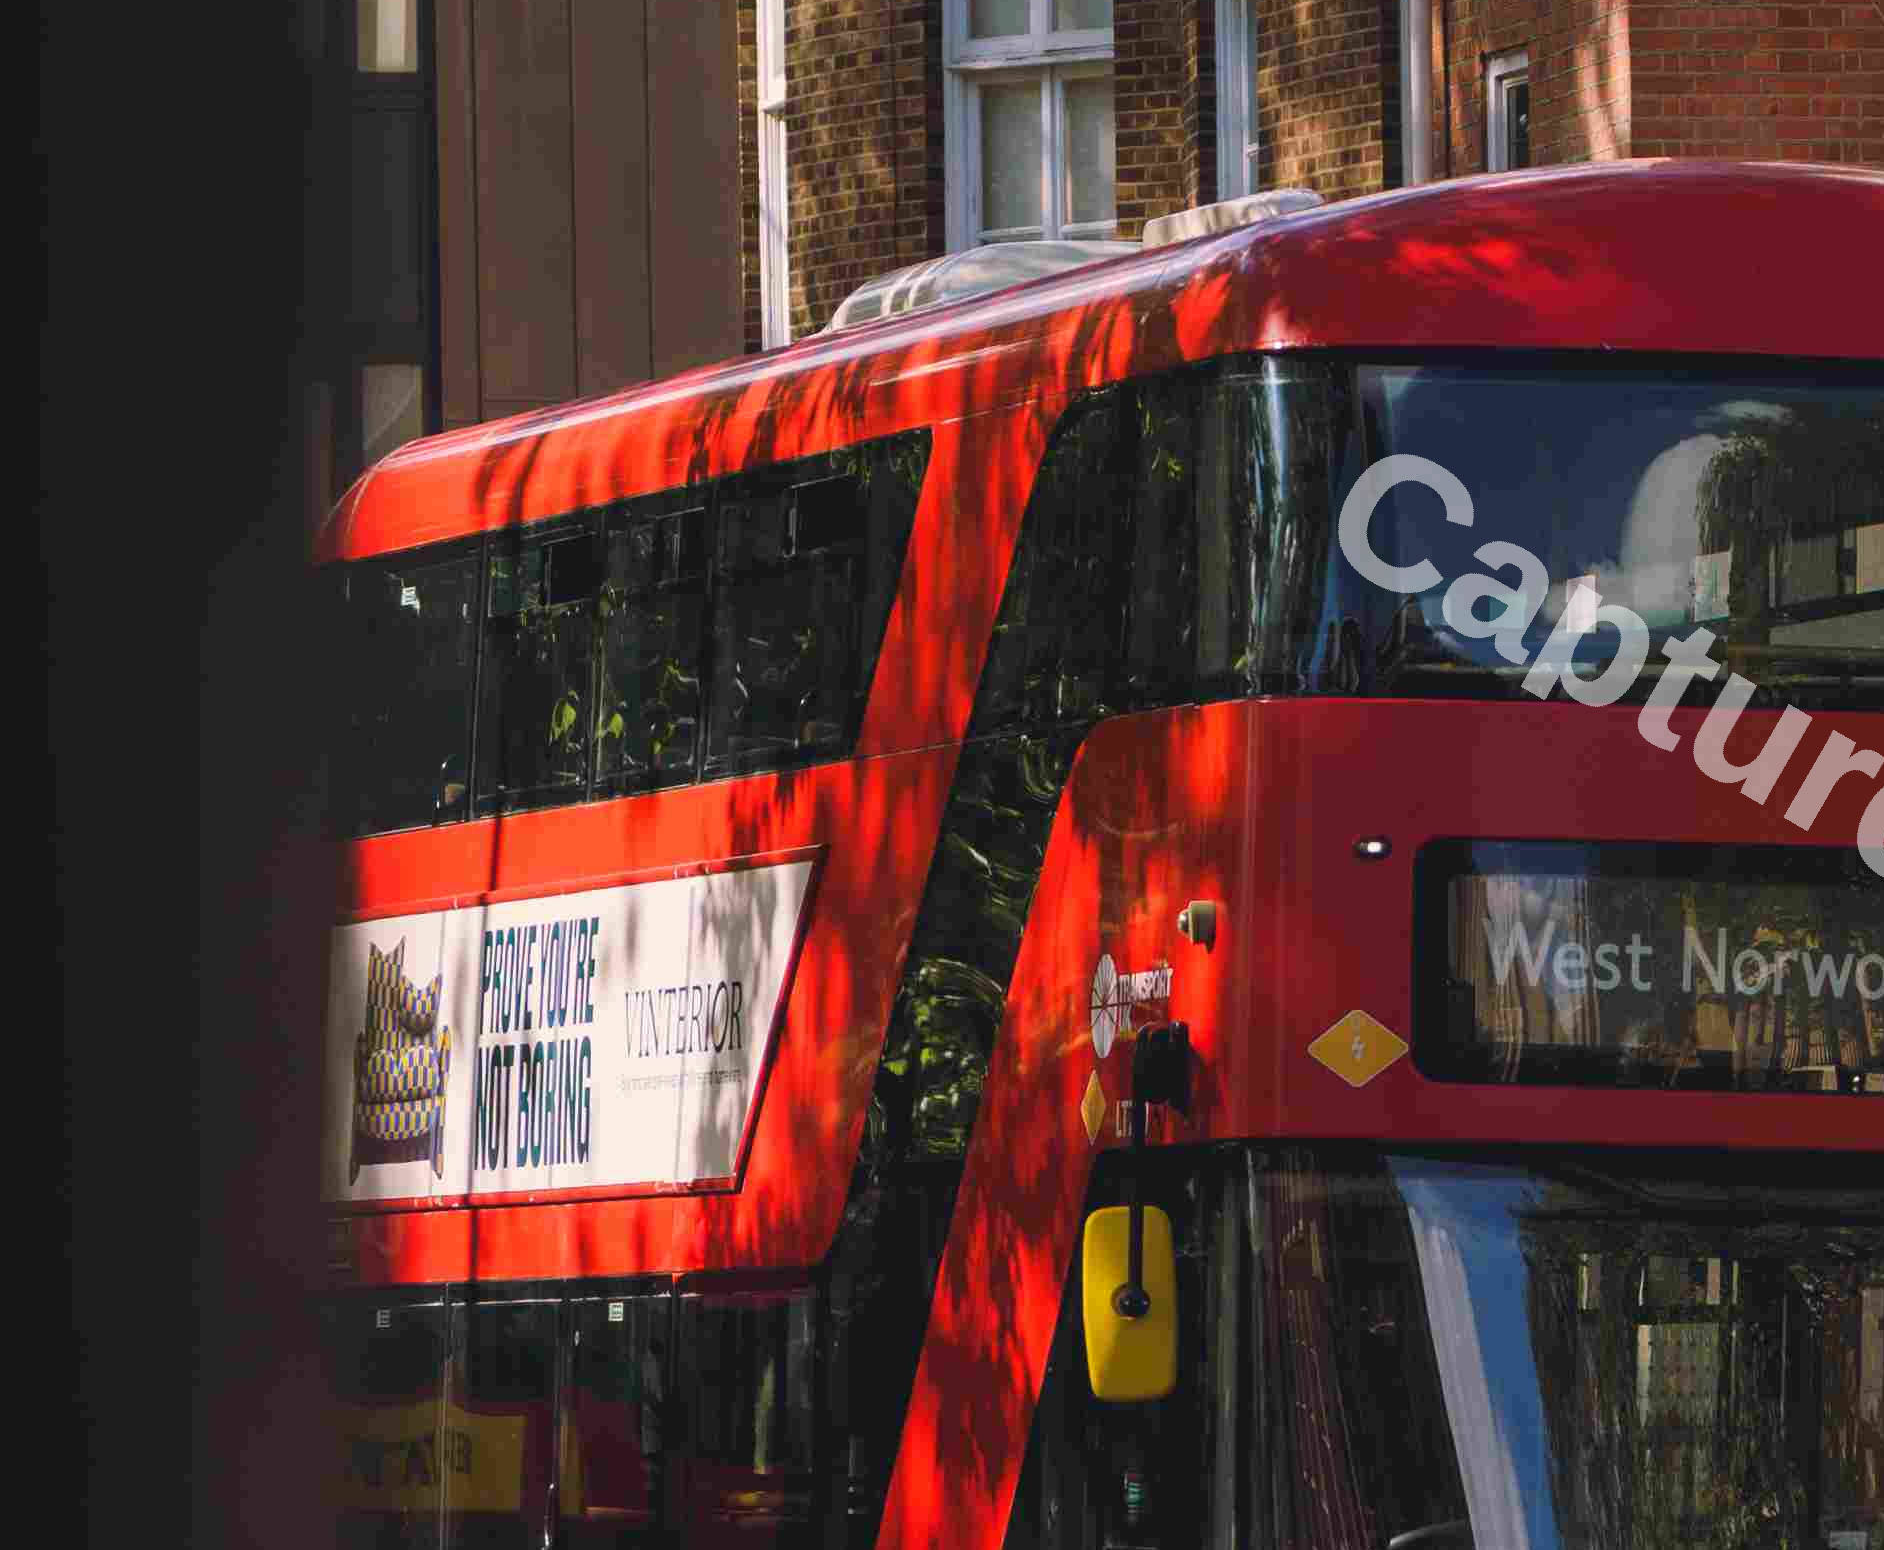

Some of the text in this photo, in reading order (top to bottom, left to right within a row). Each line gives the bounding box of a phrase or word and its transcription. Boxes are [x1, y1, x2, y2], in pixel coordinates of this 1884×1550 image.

[480, 925, 536, 1034] PROVE
[1483, 916, 1653, 992] West
[624, 980, 743, 1058] VINTERIOR
[475, 1035, 592, 1171] NOT BORING
